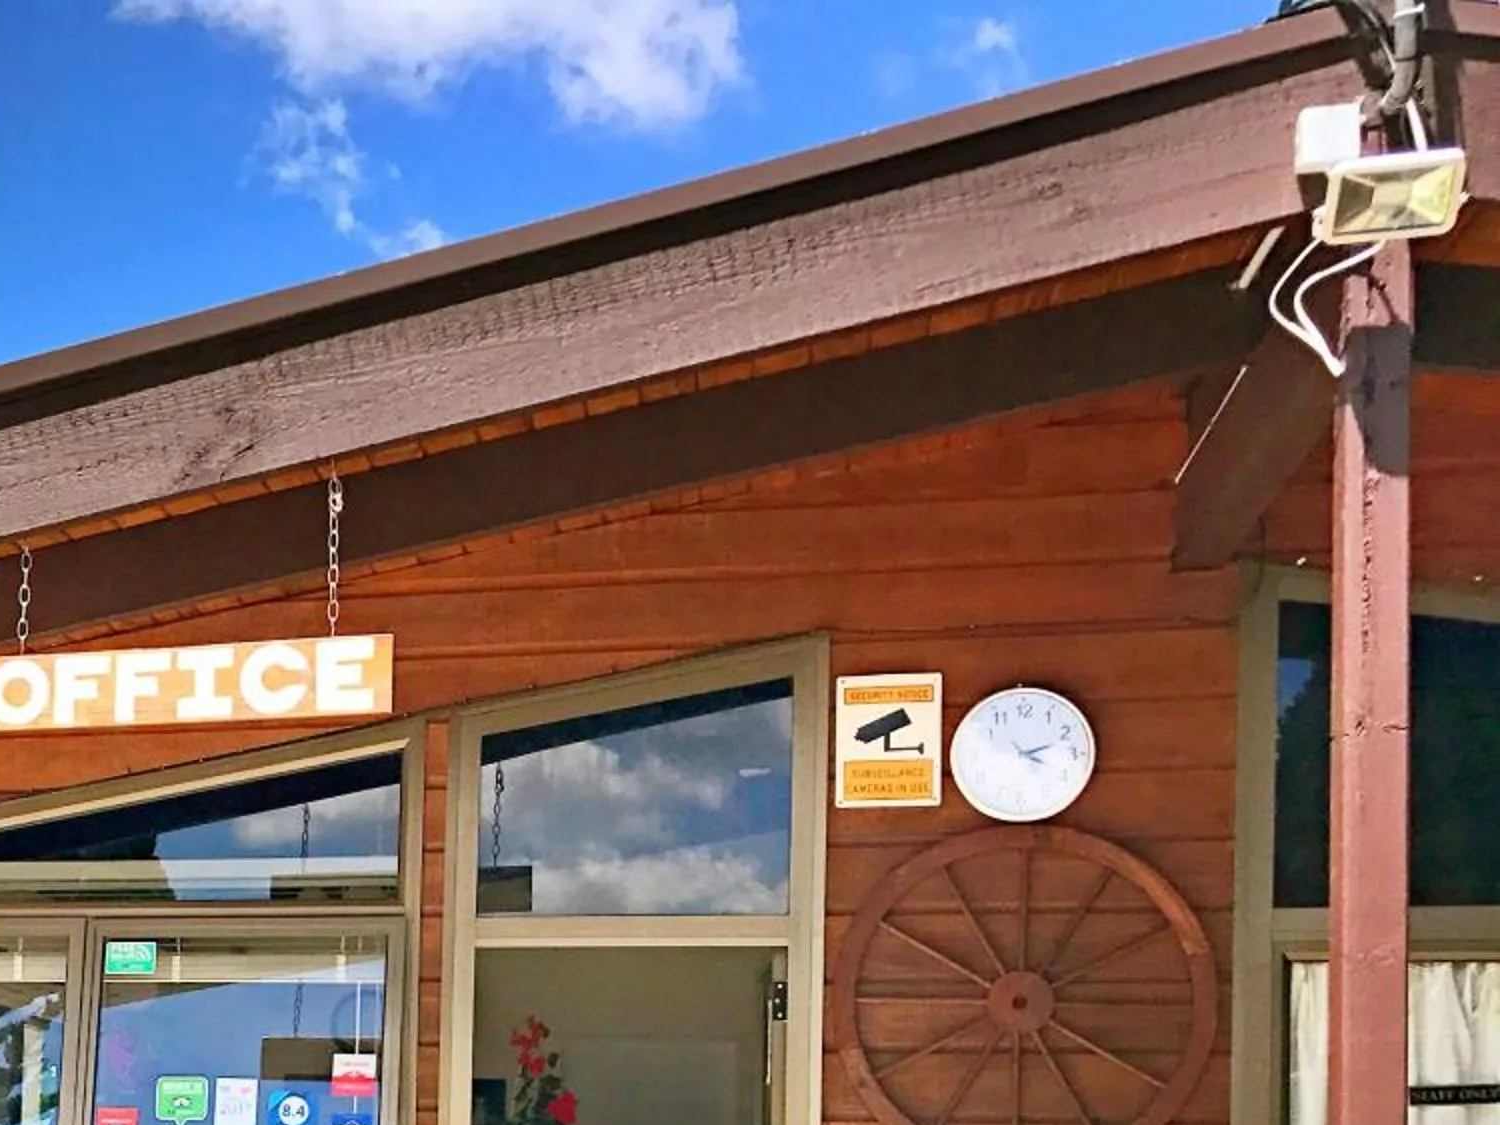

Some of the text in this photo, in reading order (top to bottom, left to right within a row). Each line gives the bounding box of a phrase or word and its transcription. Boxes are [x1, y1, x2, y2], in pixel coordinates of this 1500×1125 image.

[1016, 703, 1033, 718] 12
[1059, 725, 1071, 741] 2
[282, 1103, 305, 1118] 8.4
